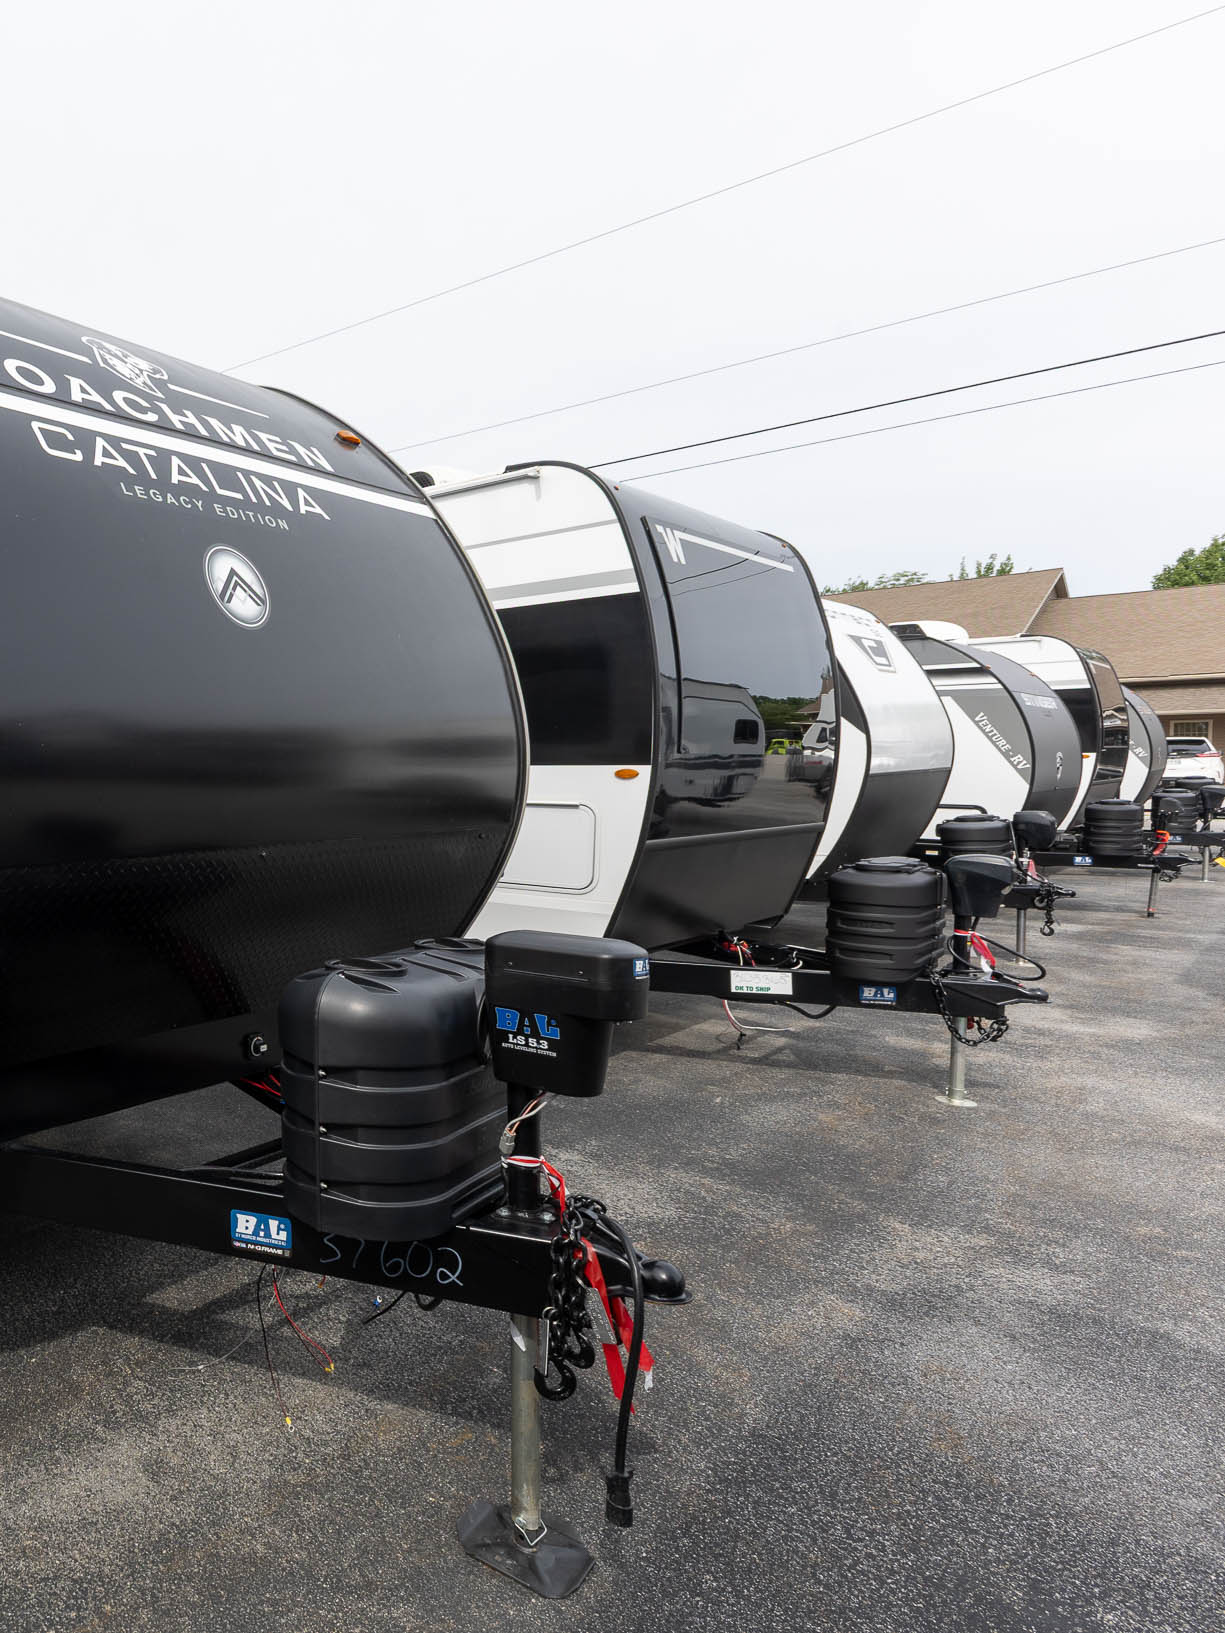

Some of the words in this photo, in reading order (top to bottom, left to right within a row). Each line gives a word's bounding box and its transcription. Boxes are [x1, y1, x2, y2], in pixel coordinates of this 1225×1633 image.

[30, 420, 332, 521] CATALINA
[119, 481, 204, 512] LEGACY
[213, 503, 289, 531] EDITION
[974, 711, 1012, 753] VENTURE
[1010, 754, 1031, 769] RV
[508, 1033, 526, 1045] LS
